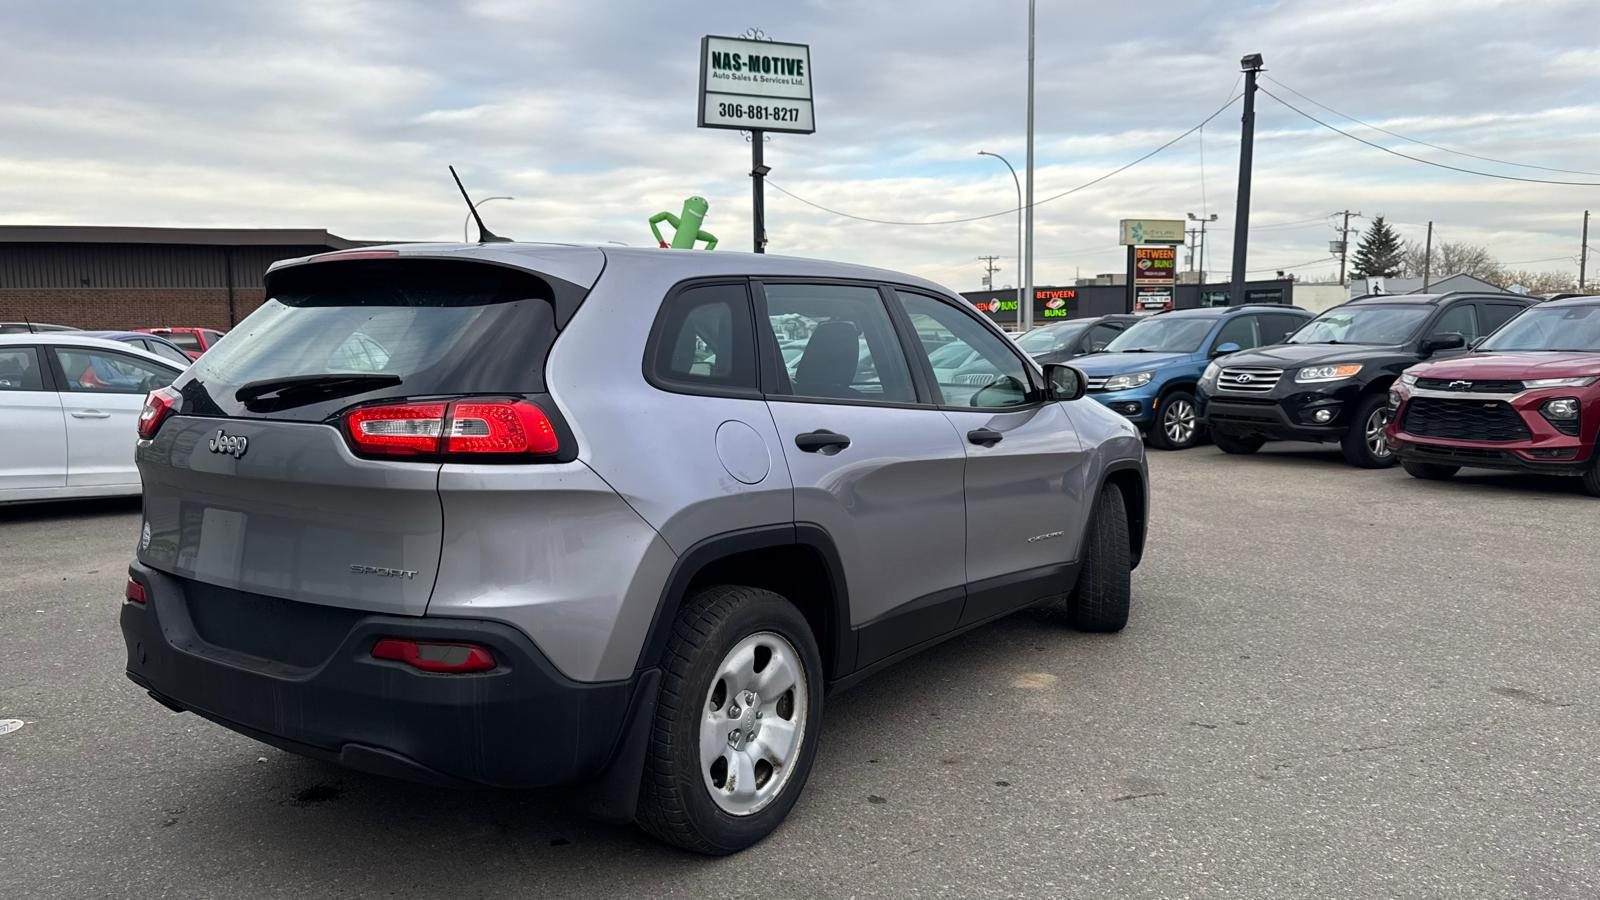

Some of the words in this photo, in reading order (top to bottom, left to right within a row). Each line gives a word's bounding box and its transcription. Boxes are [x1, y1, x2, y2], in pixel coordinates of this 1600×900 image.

[712, 51, 804, 76] NAS-MOTIVE
[712, 71, 730, 80] Auto
[731, 72, 752, 82] Sales
[760, 75, 790, 85] Services
[791, 78, 804, 86] Ltd.
[719, 102, 799, 122] 306-881-8217
[1136, 249, 1174, 258] BETWEEN
[1154, 260, 1173, 268] BUNS
[1036, 290, 1075, 298] BETWEEN
[1000, 301, 1018, 311] BUNS
[1044, 309, 1067, 317] BUNS
[209, 430, 249, 458] Jeep
[350, 564, 418, 579] SPORT
